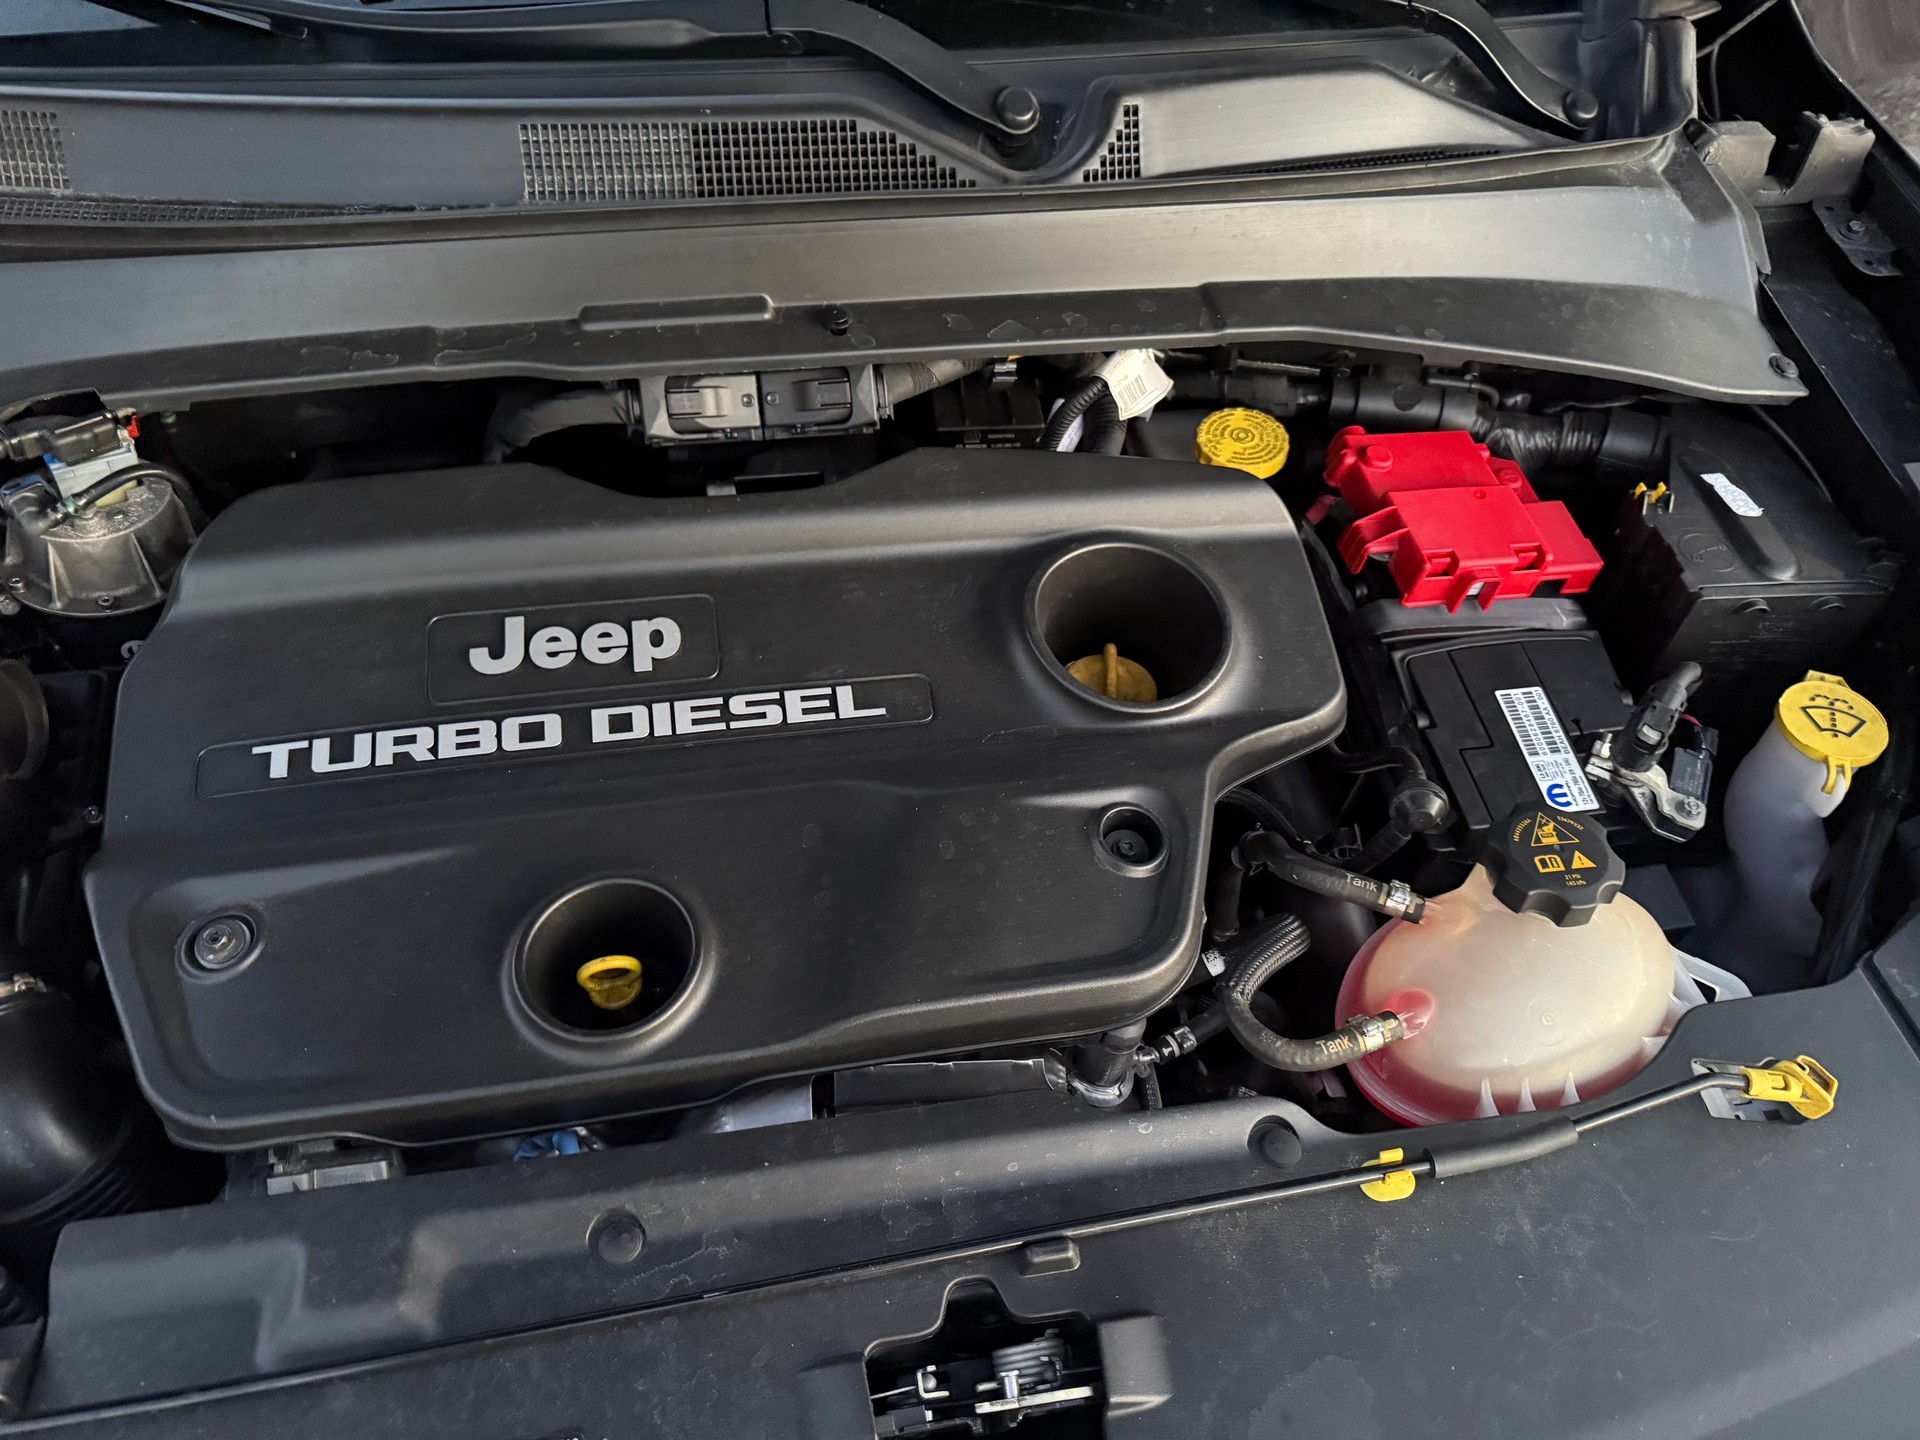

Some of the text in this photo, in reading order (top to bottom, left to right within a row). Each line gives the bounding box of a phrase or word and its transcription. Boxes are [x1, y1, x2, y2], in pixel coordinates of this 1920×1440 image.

[470, 617, 681, 674] Jeep
[252, 686, 886, 778] TURBO DIESEL
[1345, 872, 1377, 892] Tank
[1315, 1034, 1354, 1055] Tank
